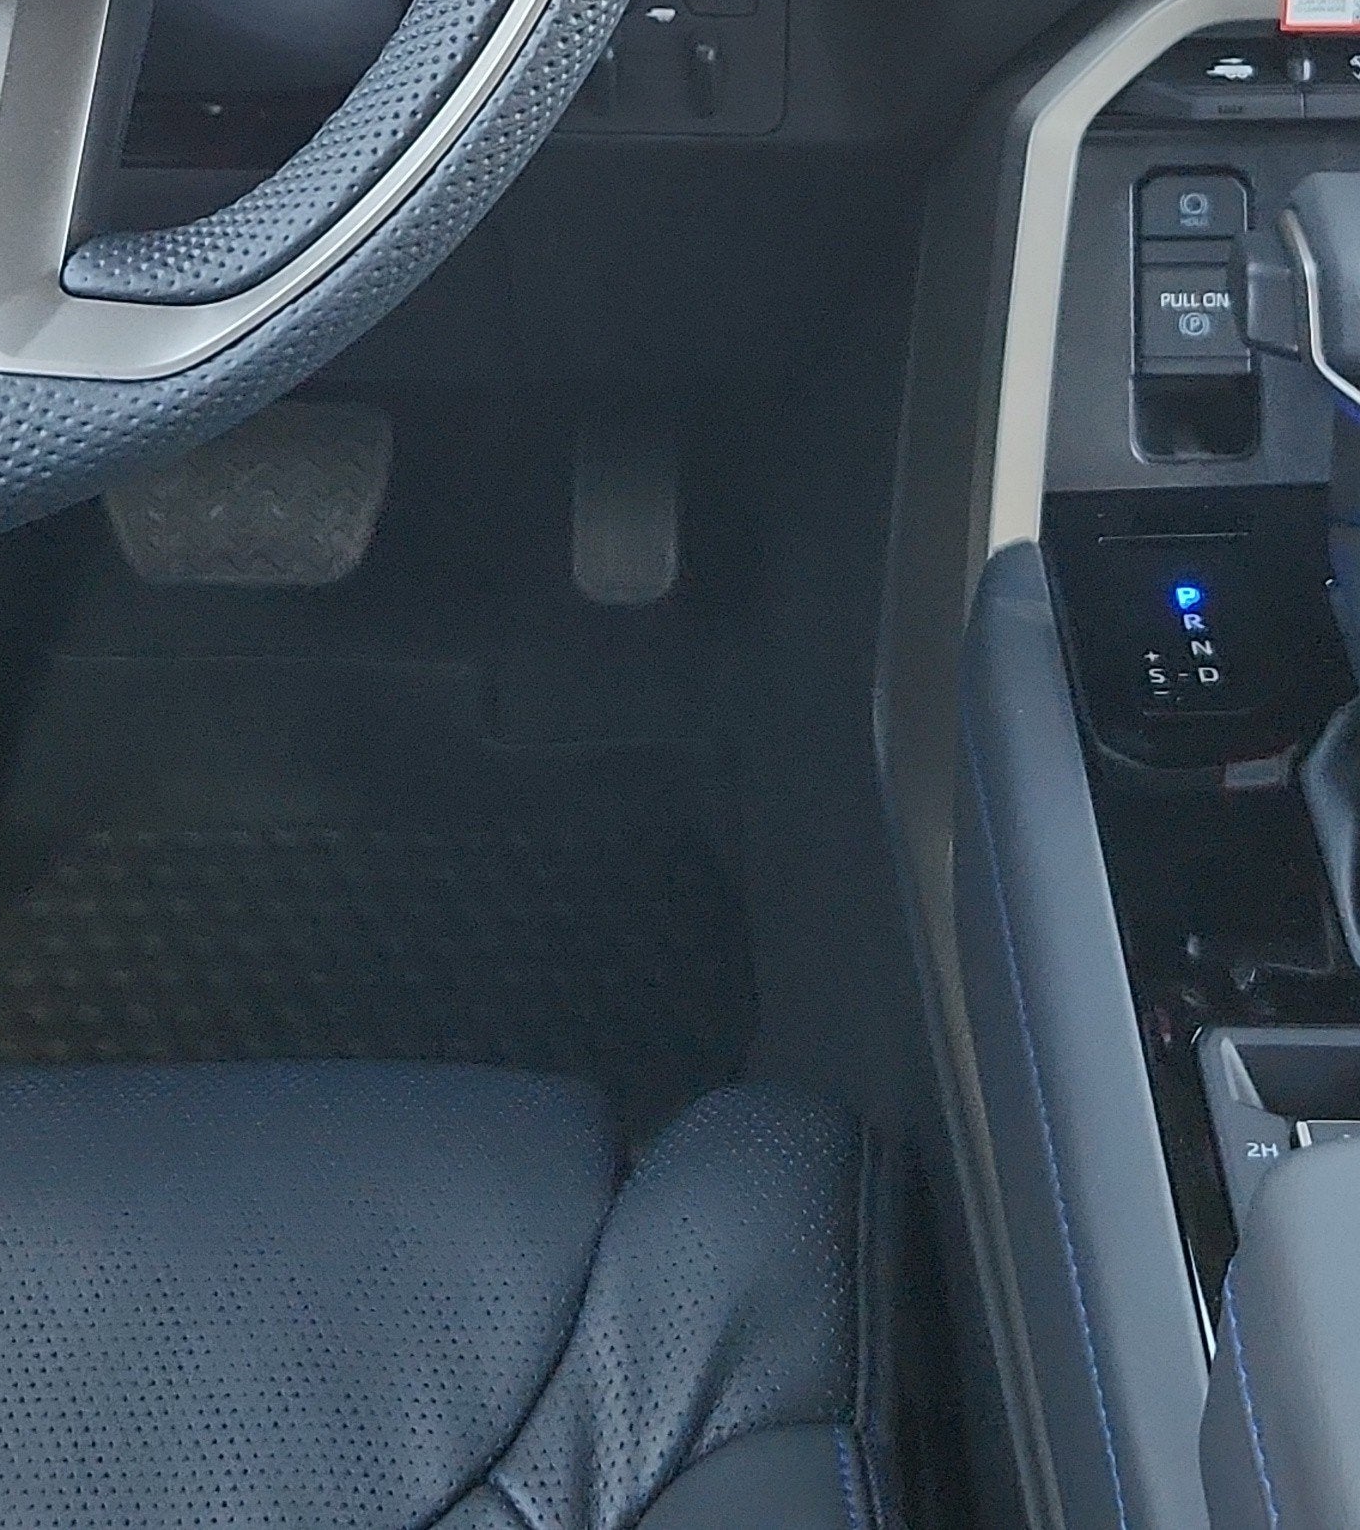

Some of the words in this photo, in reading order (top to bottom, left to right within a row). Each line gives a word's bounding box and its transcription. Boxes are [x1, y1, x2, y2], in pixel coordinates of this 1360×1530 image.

[1159, 291, 1200, 308] PULL
[1201, 291, 1230, 308] ON
[1175, 586, 1202, 610] P
[1183, 613, 1206, 631] R
[1190, 639, 1214, 657] N
[1148, 667, 1166, 685] S
[1197, 666, 1220, 683] D
[1245, 1141, 1280, 1160] 2H
